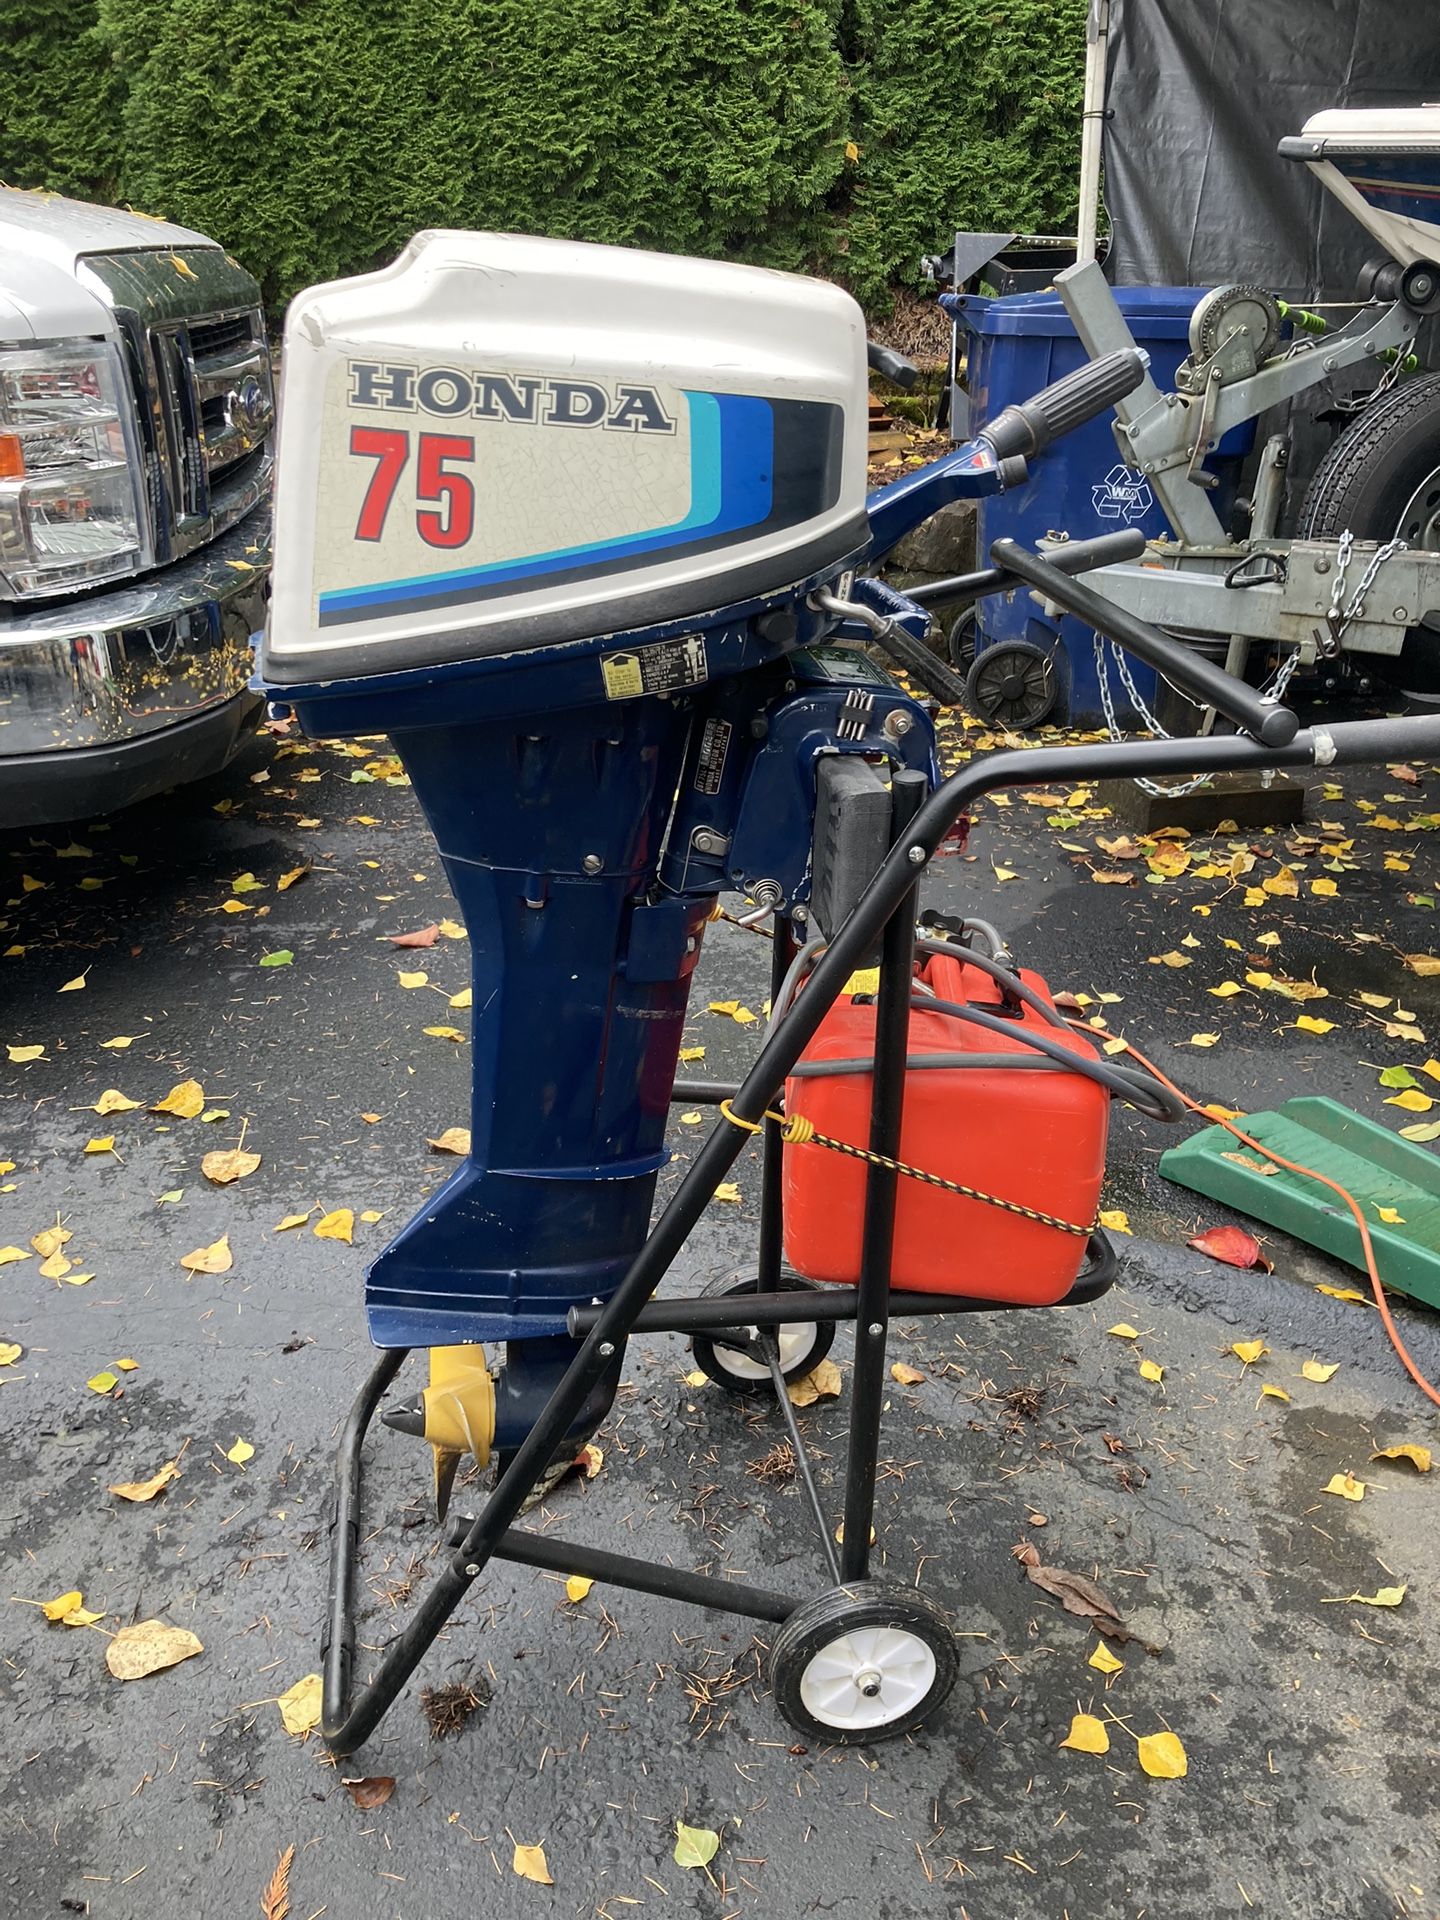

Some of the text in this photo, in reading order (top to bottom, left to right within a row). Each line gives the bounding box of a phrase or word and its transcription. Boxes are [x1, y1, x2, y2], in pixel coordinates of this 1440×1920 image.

[347, 359, 677, 435] HONDA
[349, 425, 475, 549] 75
[1112, 486, 1138, 500] WM
[708, 748, 720, 770] MOTOR
